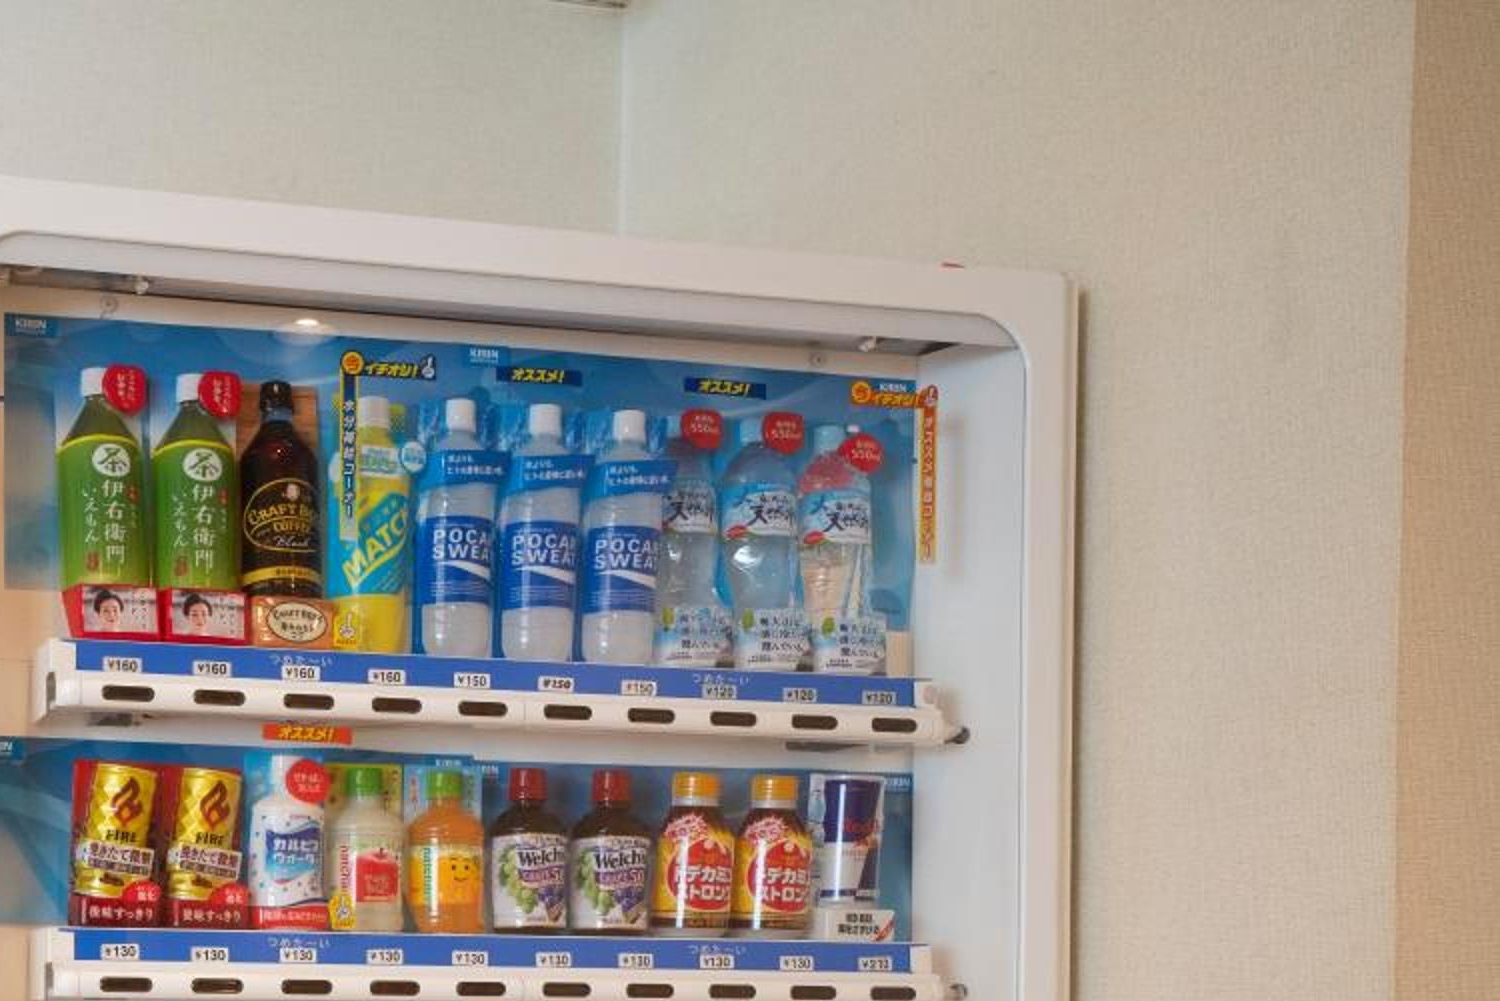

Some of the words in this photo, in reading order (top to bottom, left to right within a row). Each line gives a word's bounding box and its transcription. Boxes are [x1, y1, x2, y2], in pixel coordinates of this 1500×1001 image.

[97, 446, 129, 474] 茶
[188, 450, 220, 480] 茶
[248, 502, 297, 526] CRAFT
[101, 480, 127, 566] 伊右衛門
[192, 484, 216, 571] 伊右衛門
[342, 510, 408, 589] MATC
[432, 543, 491, 562] SWEA
[107, 658, 138, 672] ¥160
[197, 663, 228, 675] ¥160
[285, 666, 316, 679] ¥160
[372, 671, 401, 683] ¥160
[457, 675, 487, 687] ¥150
[543, 679, 572, 690] ¥150
[625, 682, 654, 694] ¥150
[706, 685, 734, 698] ¥120
[786, 689, 815, 701] ¥120
[105, 829, 138, 843] FIRE
[195, 831, 226, 846] FIRE
[105, 946, 137, 957] ¥130
[195, 949, 226, 961] ¥130
[282, 949, 313, 961] ¥130
[370, 950, 401, 962] ¥130
[454, 953, 485, 965] ¥130
[704, 956, 732, 967] ¥130
[783, 958, 811, 969] ¥130
